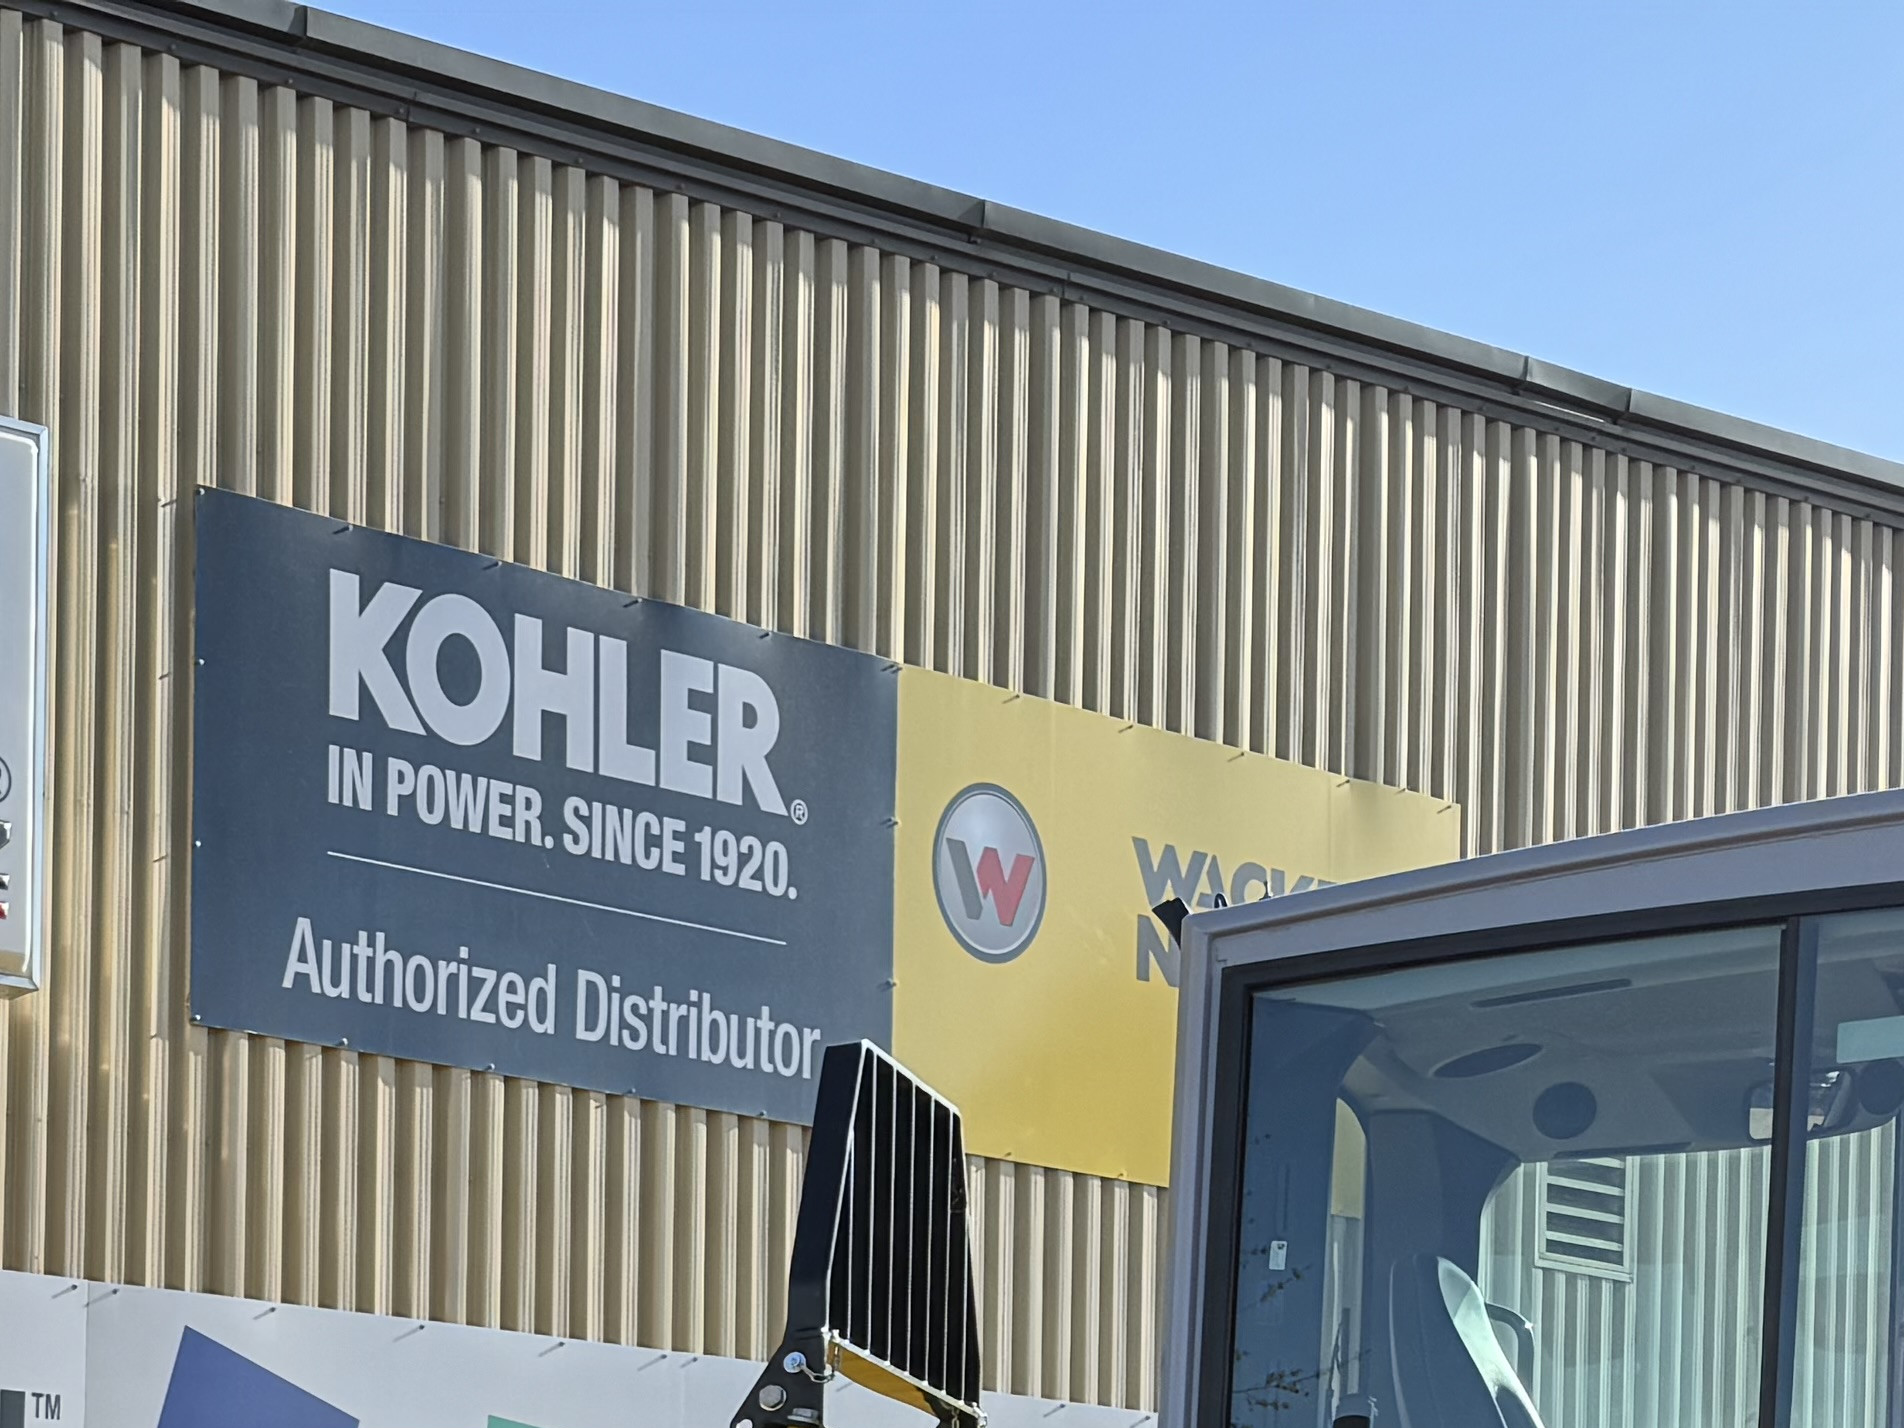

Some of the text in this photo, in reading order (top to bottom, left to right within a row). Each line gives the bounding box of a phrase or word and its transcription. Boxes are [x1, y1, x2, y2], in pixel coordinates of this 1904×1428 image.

[329, 567, 789, 816] KOHLER
[327, 745, 798, 900] IN POWER. SINCE 1920.
[1131, 836, 1338, 909] WAC
[282, 916, 822, 1080] Authorized Distributor
